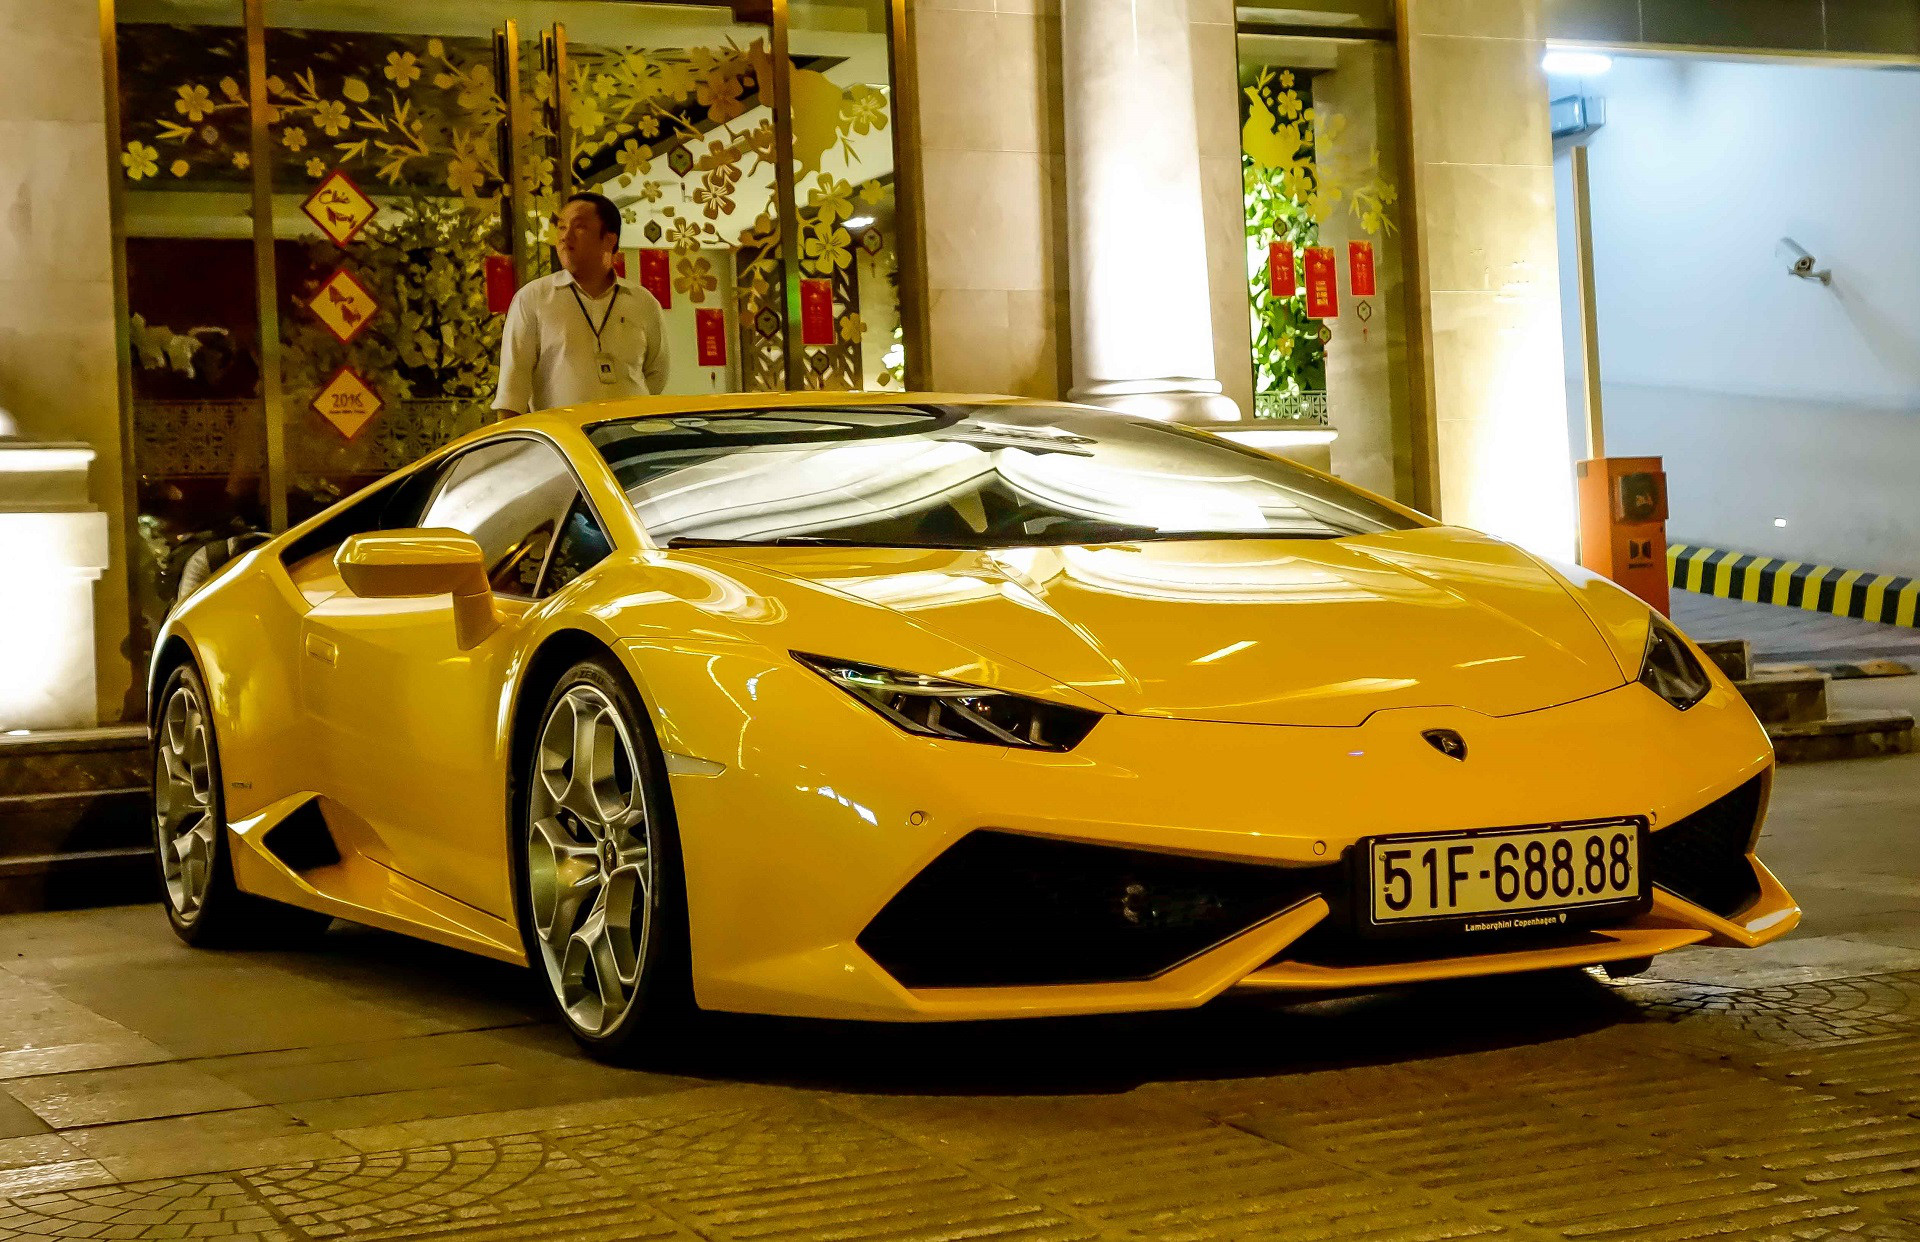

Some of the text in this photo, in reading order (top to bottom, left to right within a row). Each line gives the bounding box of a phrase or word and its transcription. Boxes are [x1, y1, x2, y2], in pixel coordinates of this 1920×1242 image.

[1384, 833, 1630, 911] 51F-688.88
[1465, 917, 1557, 932] Lamborghini Copenhagen
